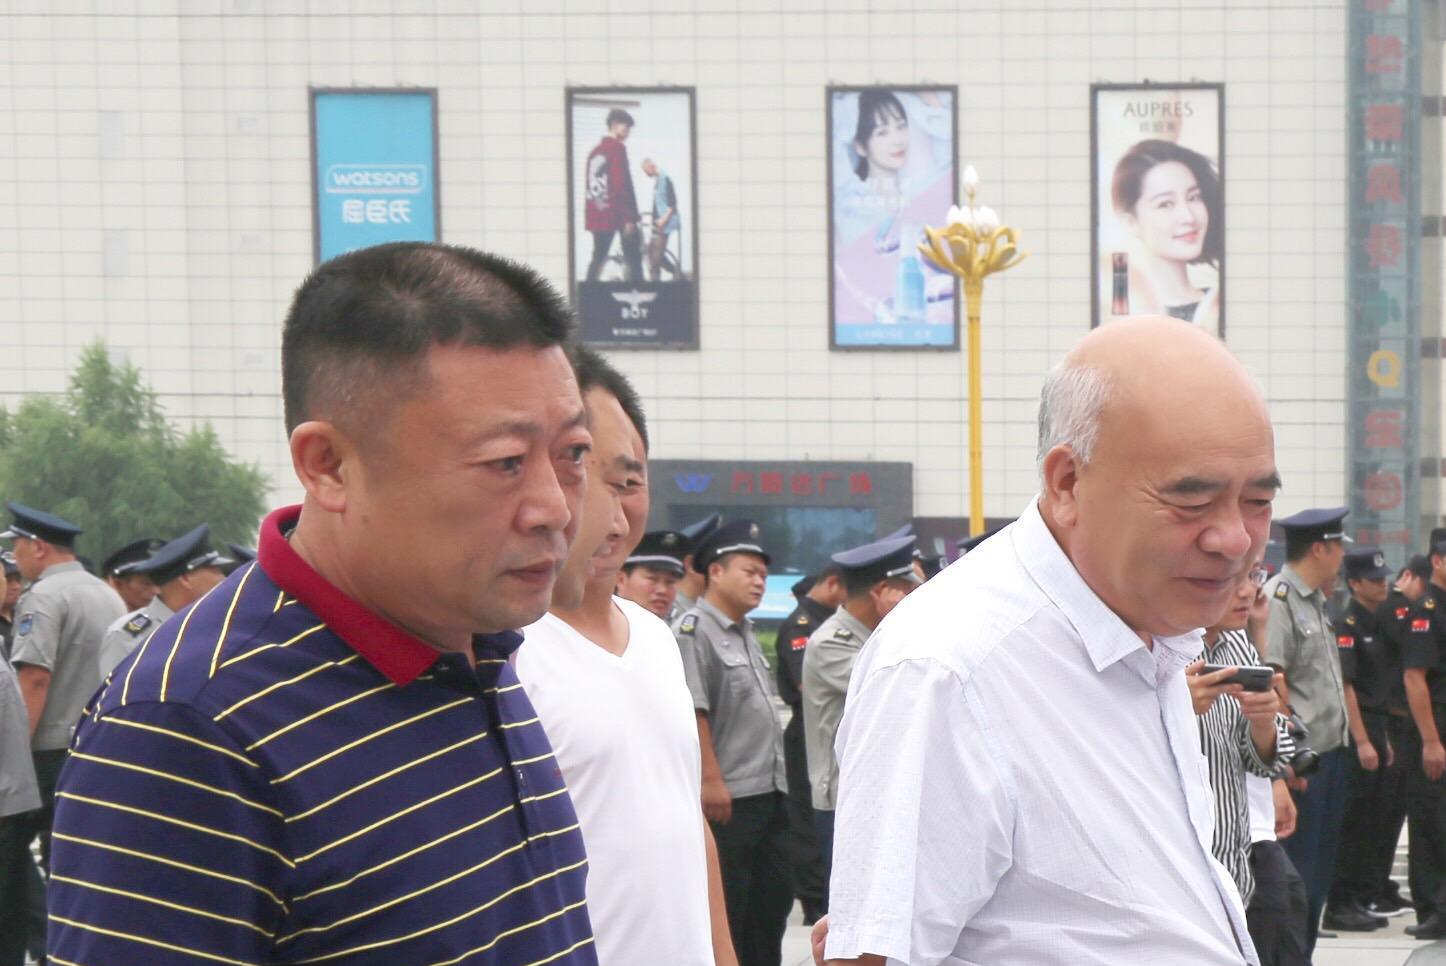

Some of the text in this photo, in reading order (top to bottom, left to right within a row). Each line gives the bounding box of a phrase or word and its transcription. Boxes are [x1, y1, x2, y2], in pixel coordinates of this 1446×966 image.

[1123, 102, 1194, 117] AUPRES
[333, 171, 419, 186] watsons
[342, 199, 411, 224] 屈臣氏
[621, 306, 649, 320] BOY
